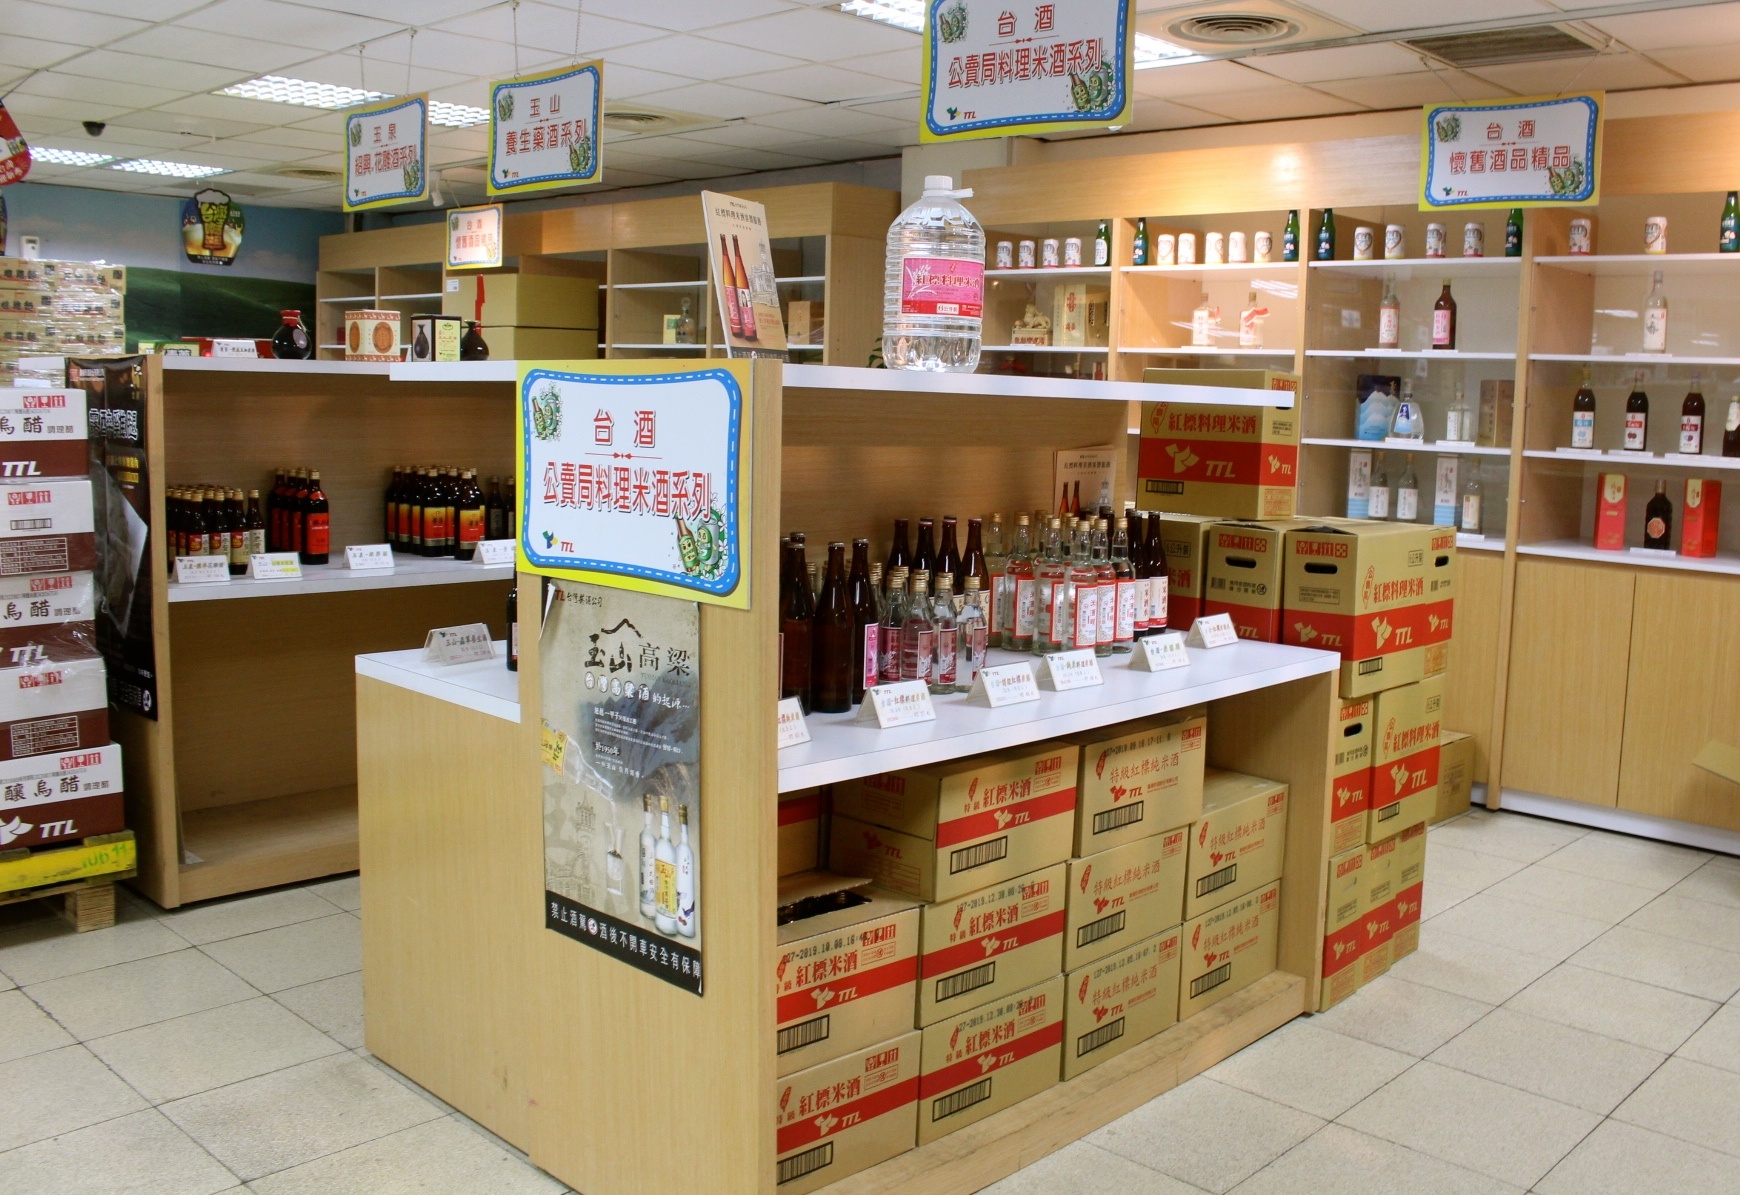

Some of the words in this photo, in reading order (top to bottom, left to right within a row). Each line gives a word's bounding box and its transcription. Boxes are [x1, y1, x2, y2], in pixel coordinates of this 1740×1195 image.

[997, 3, 1056, 38] 台酒
[948, 37, 1103, 89] 公賣局料理米酒系列
[530, 92, 560, 118] 玉山
[963, 111, 977, 120] TTL
[506, 117, 587, 156] 養生藥酒系列
[1486, 120, 1537, 142] 台酒
[1449, 145, 1572, 175] 懷舊酒品精品
[592, 408, 657, 448] 台酒
[1168, 412, 1257, 435] 紅標料理米酒
[2, 461, 42, 477] TTL
[1205, 460, 1236, 478] TTL
[1281, 463, 1292, 475] TTL
[542, 460, 713, 520] 公賣局料理米酒系列
[560, 540, 575, 553] TTL
[1373, 576, 1424, 603] 紅標料理米酒
[3, 599, 50, 620] 烏醋
[1239, 625, 1260, 639] TTL
[1440, 619, 1449, 630] TTL
[1321, 633, 1343, 647] TTL
[1395, 626, 1413, 646] TTL
[10, 644, 48, 664] TTL
[1393, 720, 1440, 752] 紅標料理米酒
[1110, 752, 1179, 783] 特級紅標純米酒
[4, 774, 80, 802] 釀烏醋
[1411, 769, 1428, 789] TTL
[983, 777, 1031, 808] 紅標米酒
[1129, 787, 1142, 798] TTL
[1352, 790, 1363, 803] TTL
[1015, 811, 1031, 825] TTL
[40, 820, 79, 838] TTL
[885, 846, 902, 859] TTL
[1225, 851, 1236, 862] TTL
[1093, 860, 1160, 896] 特級紅標純米酒
[1112, 896, 1124, 908] TTL
[1409, 901, 1418, 914] TTL
[969, 903, 1019, 936] 紅標米酒
[1379, 920, 1390, 934] TTL
[1003, 937, 1019, 951] TTL
[1346, 940, 1356, 954] TTL
[1219, 950, 1230, 962] TTL
[796, 949, 858, 987] 紅標米酒
[838, 986, 858, 1002] TTL
[1111, 1004, 1123, 1016] TTL
[965, 1019, 1015, 1055] 紅標米酒
[999, 1051, 1015, 1066] TTL
[799, 1075, 861, 1117] 紅標米酒
[842, 1111, 861, 1128] TTL
